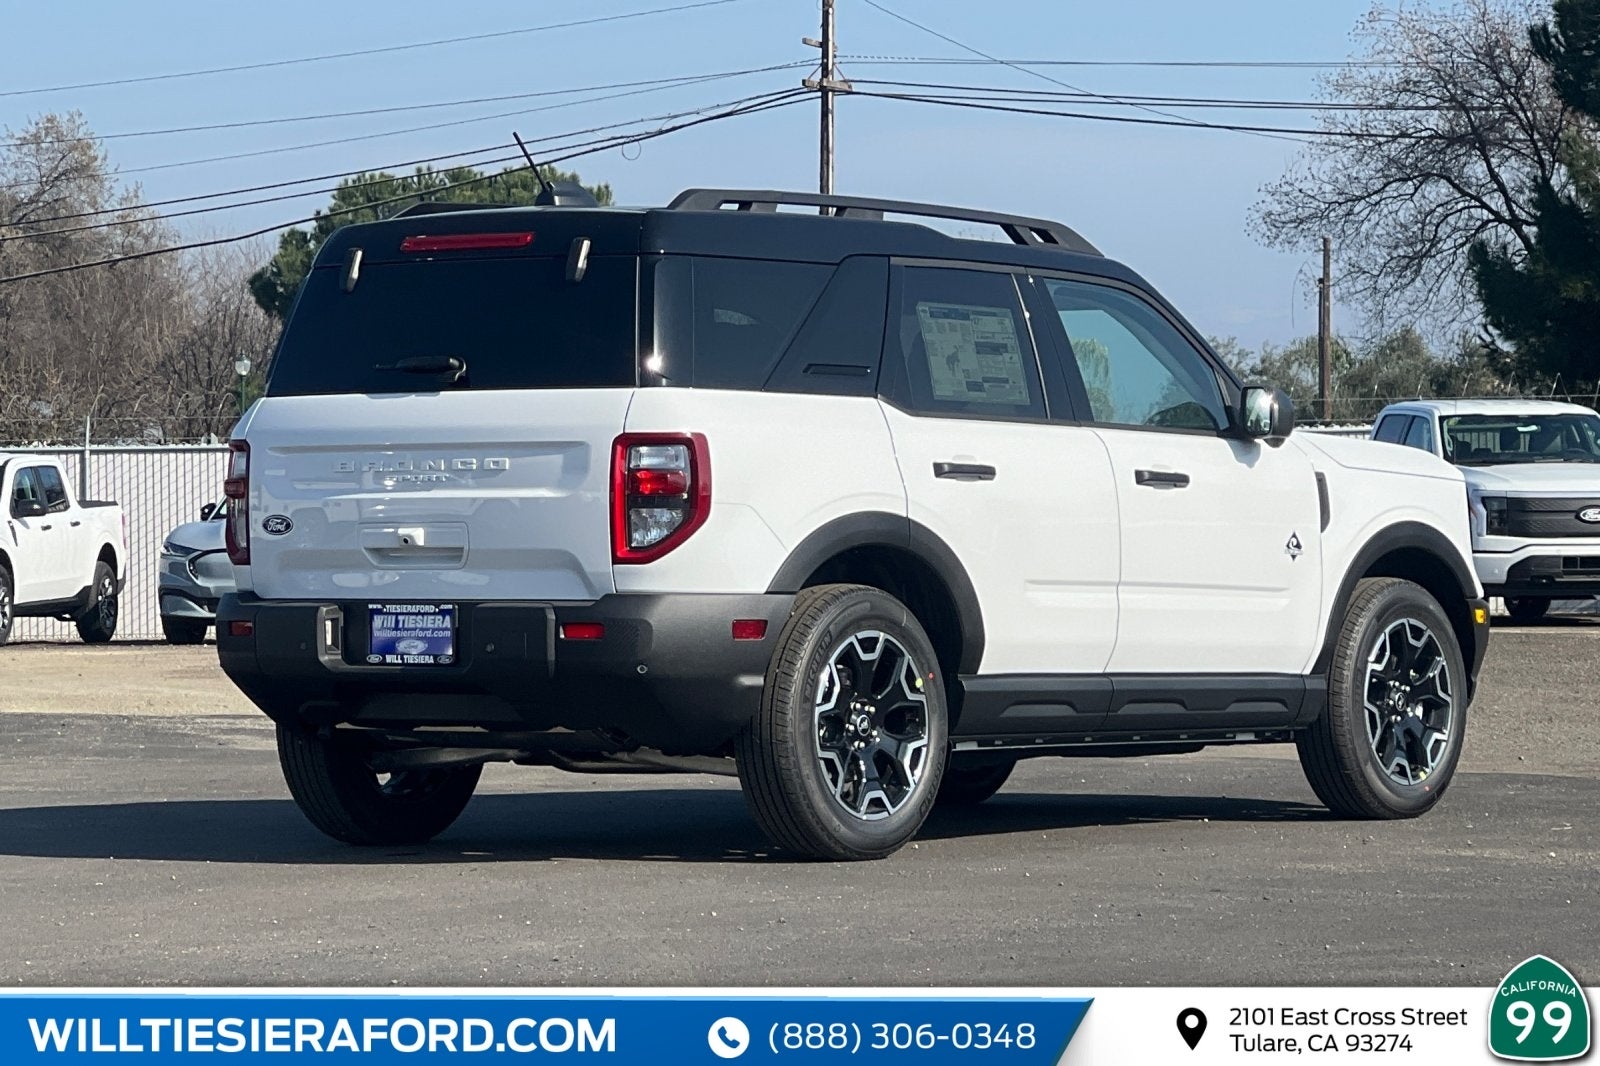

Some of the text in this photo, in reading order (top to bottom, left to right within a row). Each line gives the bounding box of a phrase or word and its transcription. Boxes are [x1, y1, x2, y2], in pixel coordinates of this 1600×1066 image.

[333, 457, 509, 472] BRONCO
[267, 518, 287, 531] Ford
[398, 614, 451, 628] TIESIERA
[385, 655, 402, 663] WILL
[403, 655, 434, 663] TIESIERA
[804, 629, 832, 699] MICHELIN
